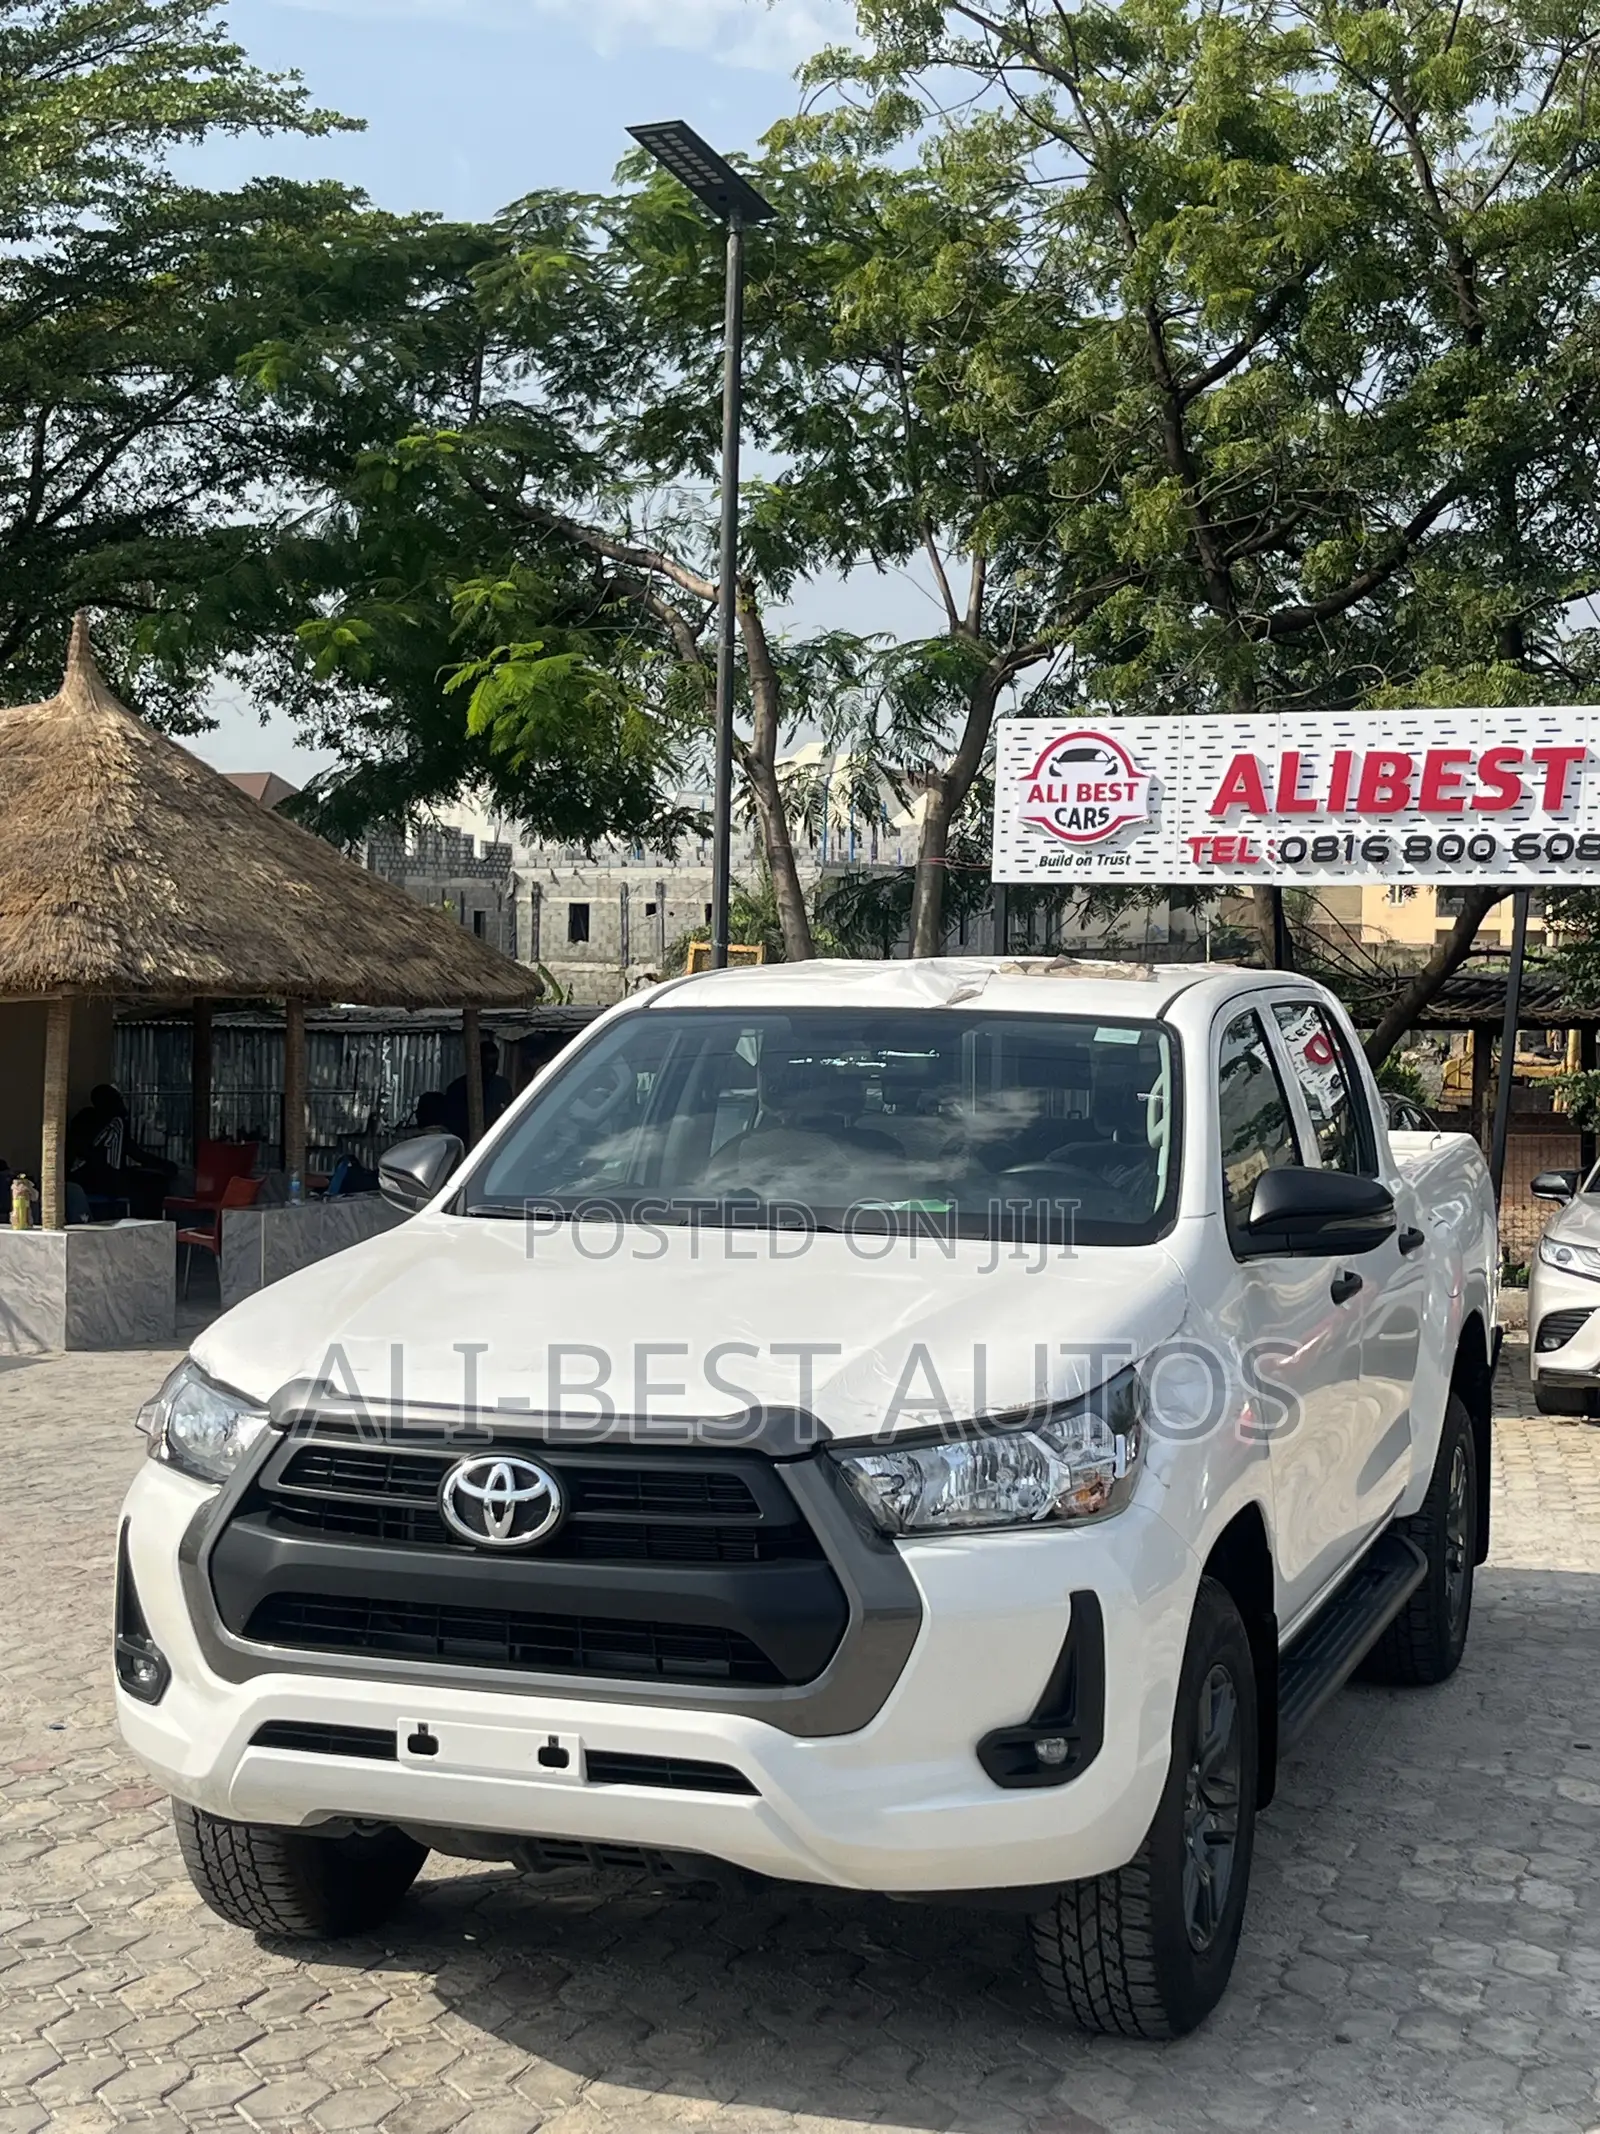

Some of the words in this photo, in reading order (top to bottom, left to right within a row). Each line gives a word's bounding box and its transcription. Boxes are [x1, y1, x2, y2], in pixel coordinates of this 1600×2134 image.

[1209, 747, 1586, 815] ALIBEST
[1027, 784, 1068, 803] ALI
[1076, 783, 1139, 802] BEST
[1055, 807, 1110, 830] CARS
[1038, 854, 1073, 867] Build
[1076, 856, 1093, 867] on
[1097, 853, 1132, 866] Trust
[1402, 833, 1497, 864] 800
